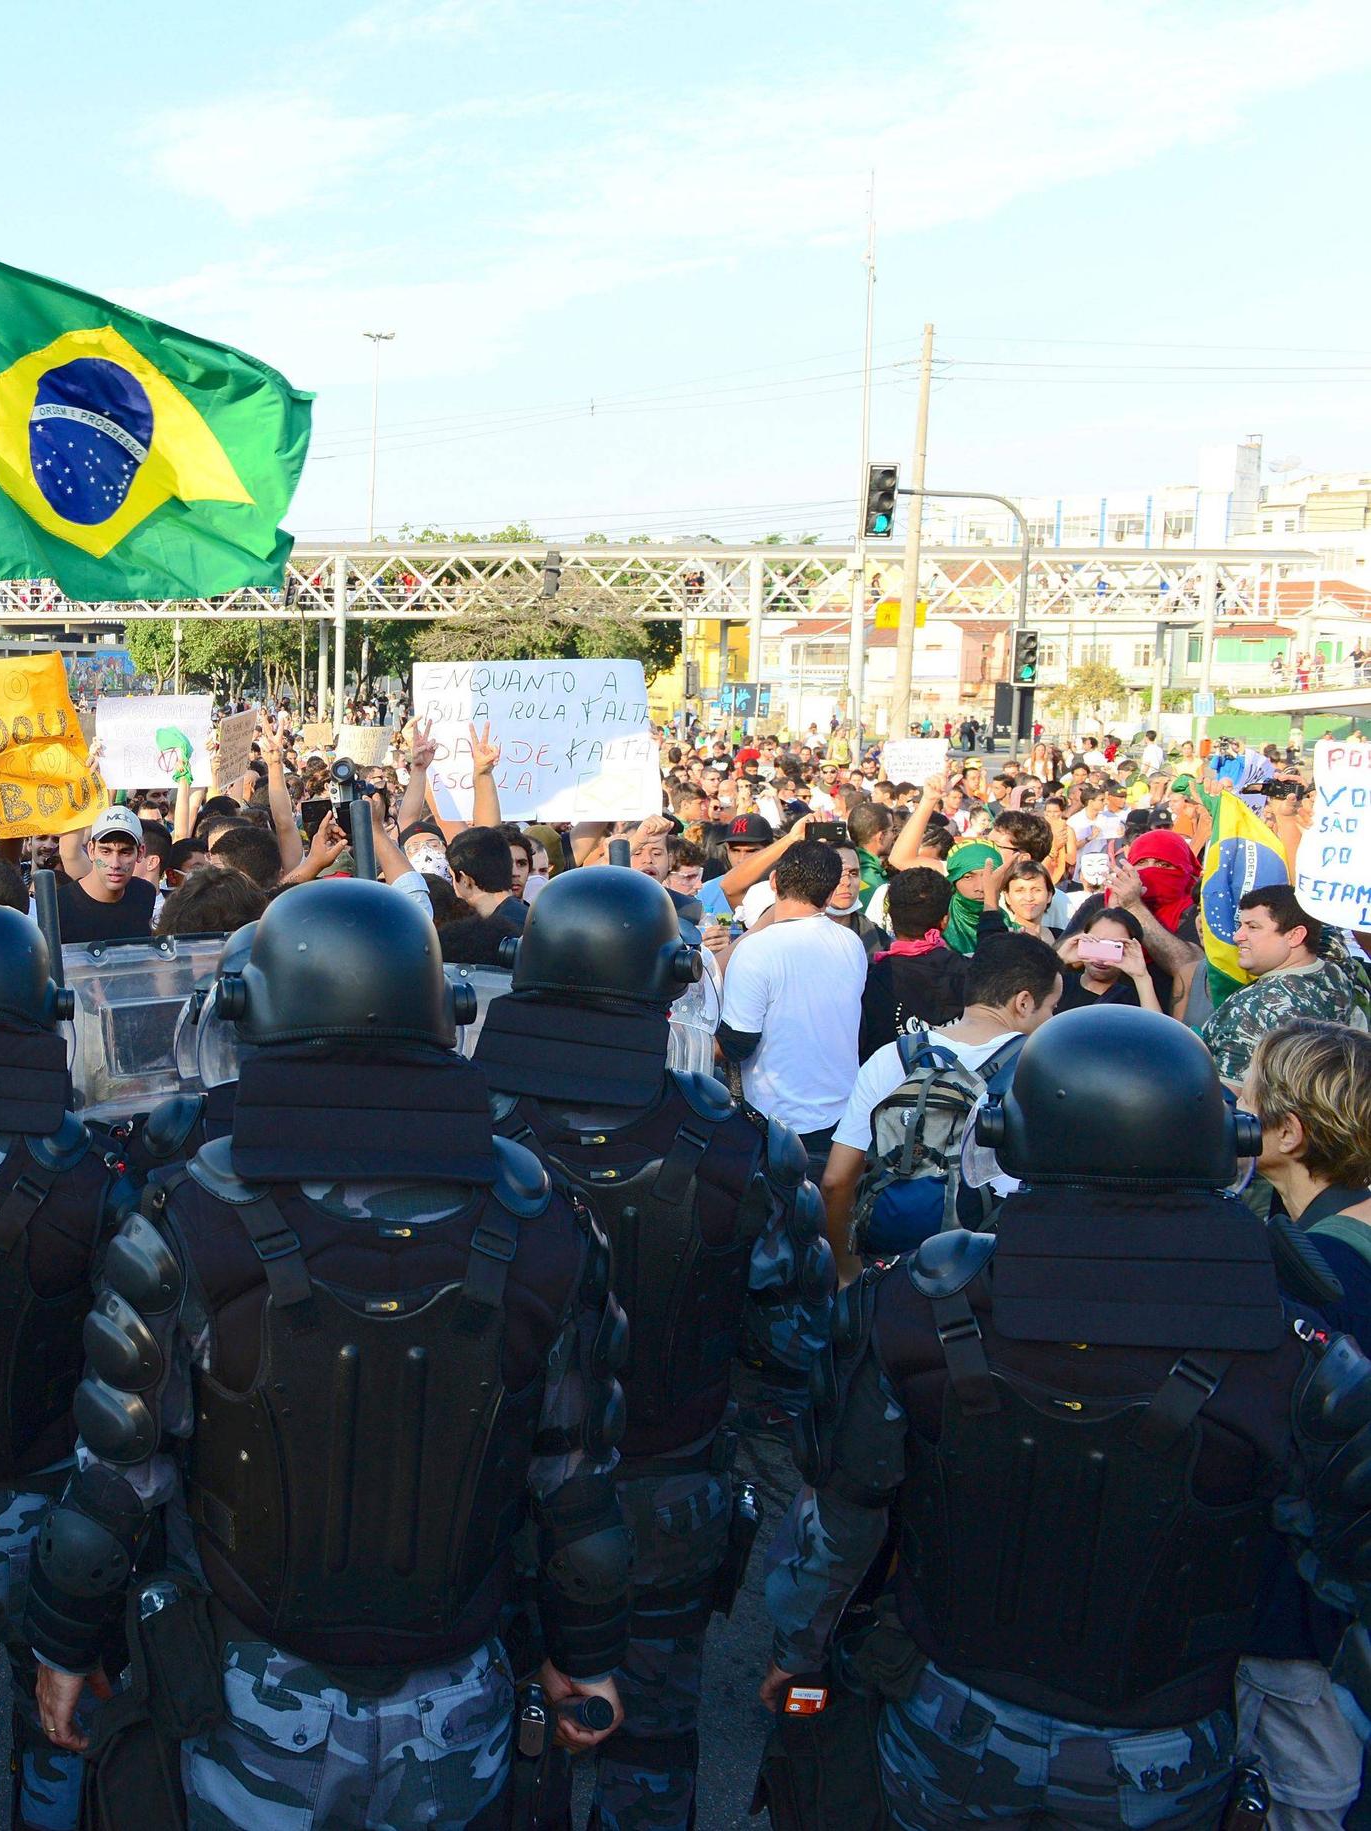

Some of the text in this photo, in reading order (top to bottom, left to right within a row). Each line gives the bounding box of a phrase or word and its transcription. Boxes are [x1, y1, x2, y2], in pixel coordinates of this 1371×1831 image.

[39, 406, 67, 417] ORDEM
[80, 412, 144, 457] PROGRESSO
[421, 667, 618, 697] ENQUANTO A
[1319, 811, 1358, 834] SÃO
[1246, 844, 1256, 878] ORDEM
[1321, 846, 1352, 868] DO
